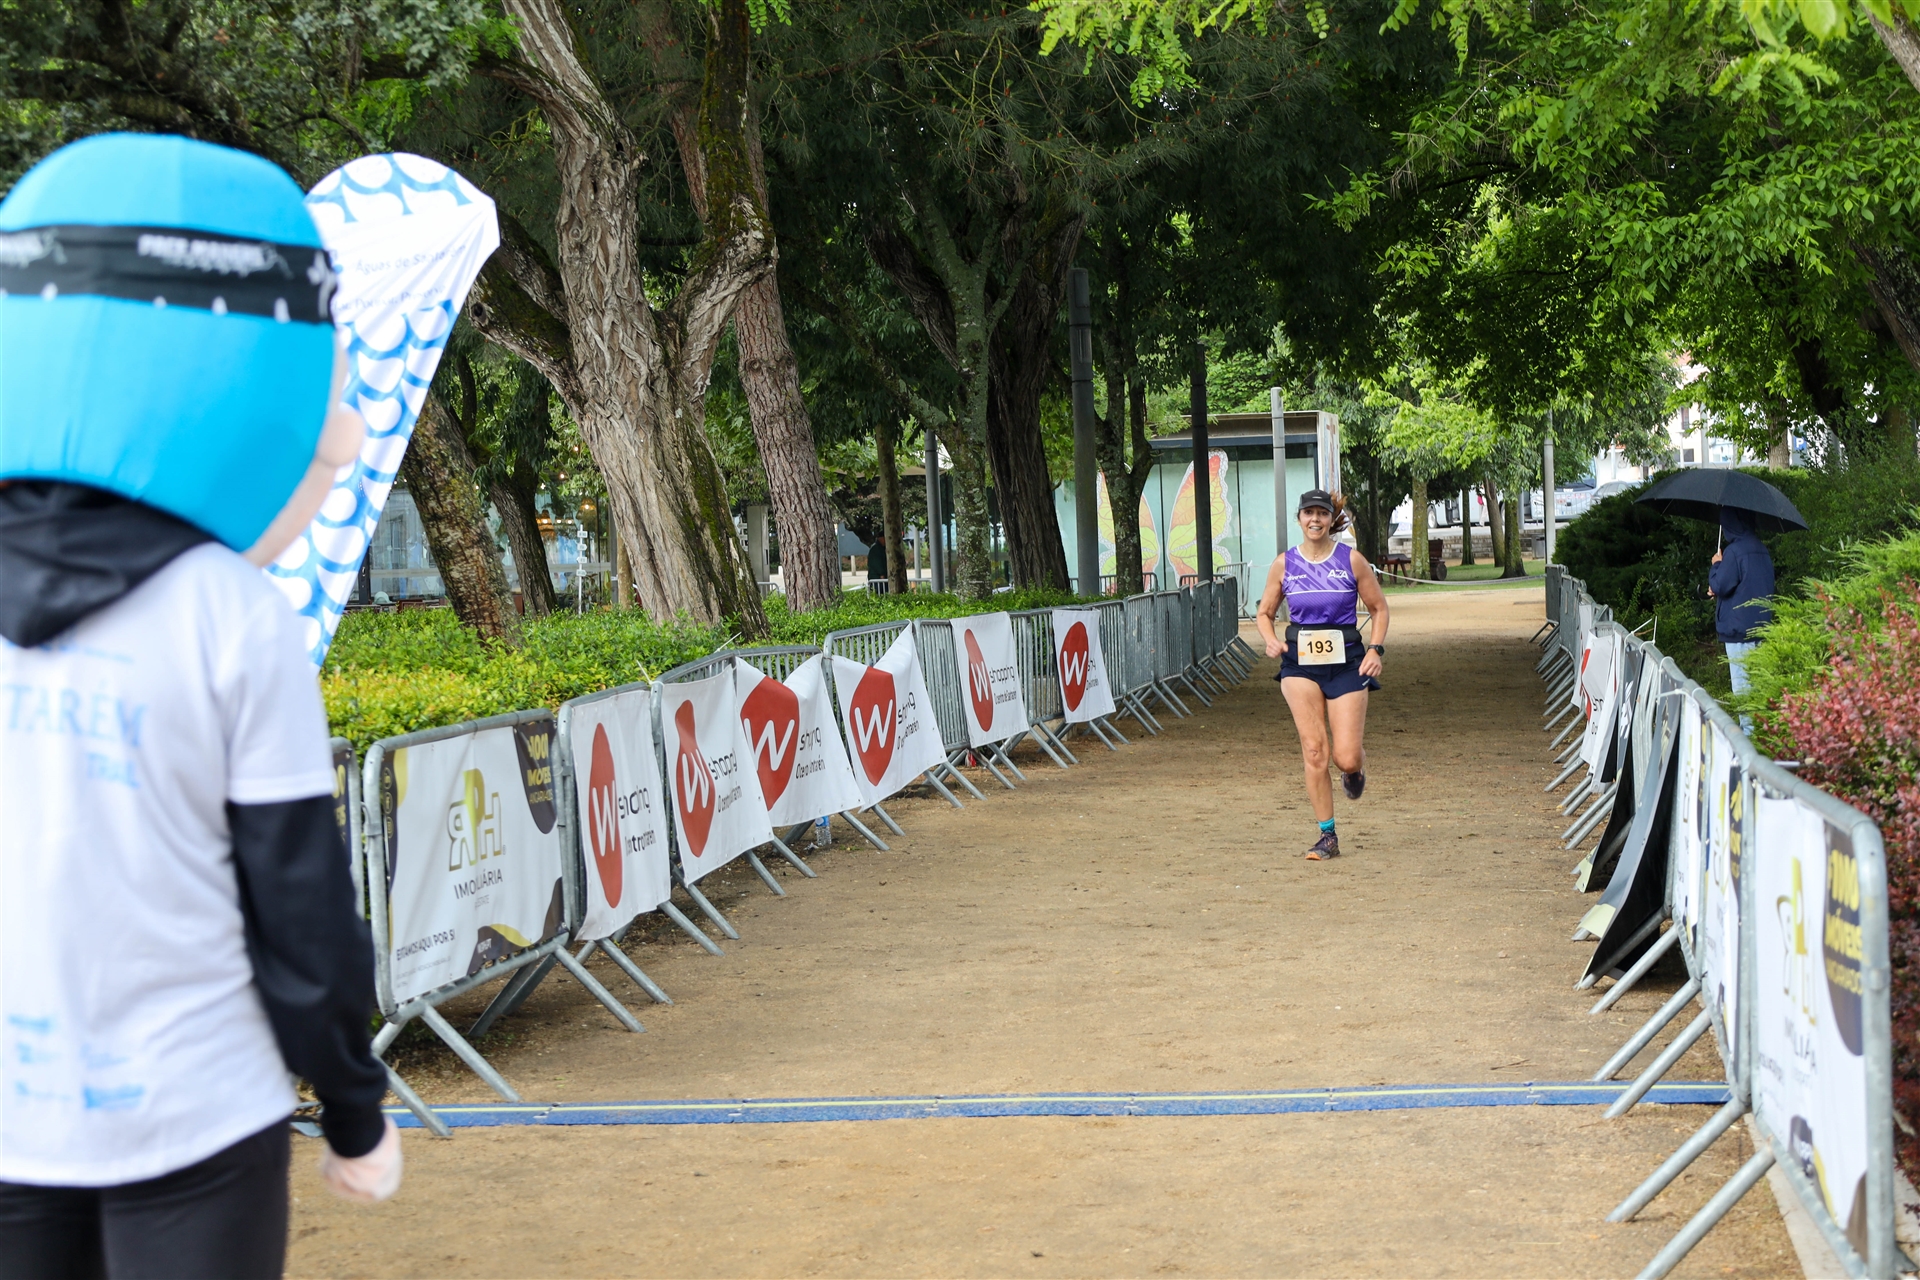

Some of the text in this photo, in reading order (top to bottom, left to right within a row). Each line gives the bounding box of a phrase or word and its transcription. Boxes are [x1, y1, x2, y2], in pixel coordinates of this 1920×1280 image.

[1796, 437, 1804, 448] P
[1307, 640, 1334, 654] 193
[854, 698, 893, 753] W
[592, 779, 616, 857] W
